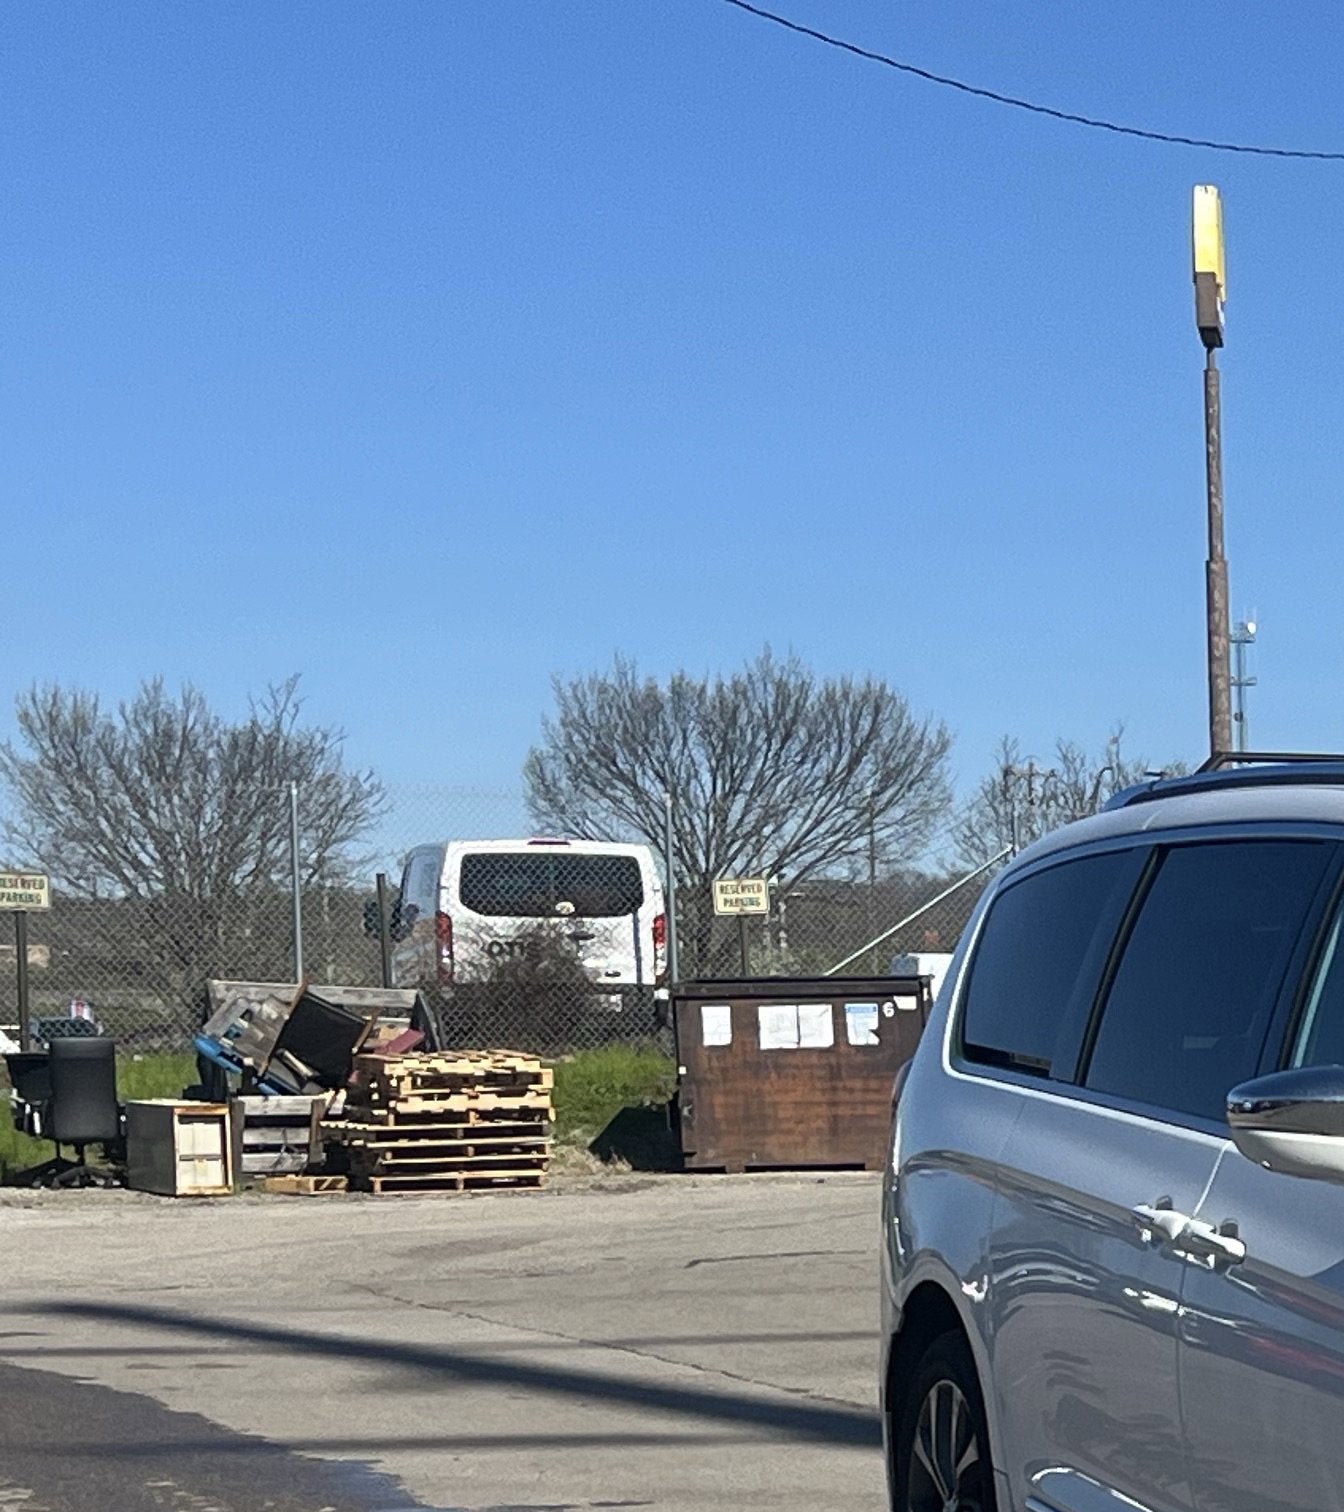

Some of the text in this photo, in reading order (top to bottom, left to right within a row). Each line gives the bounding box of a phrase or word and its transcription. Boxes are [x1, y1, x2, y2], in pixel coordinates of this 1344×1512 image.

[719, 883, 763, 894] RESERVED
[0, 892, 42, 904] PARKING
[723, 897, 761, 907] PARKING
